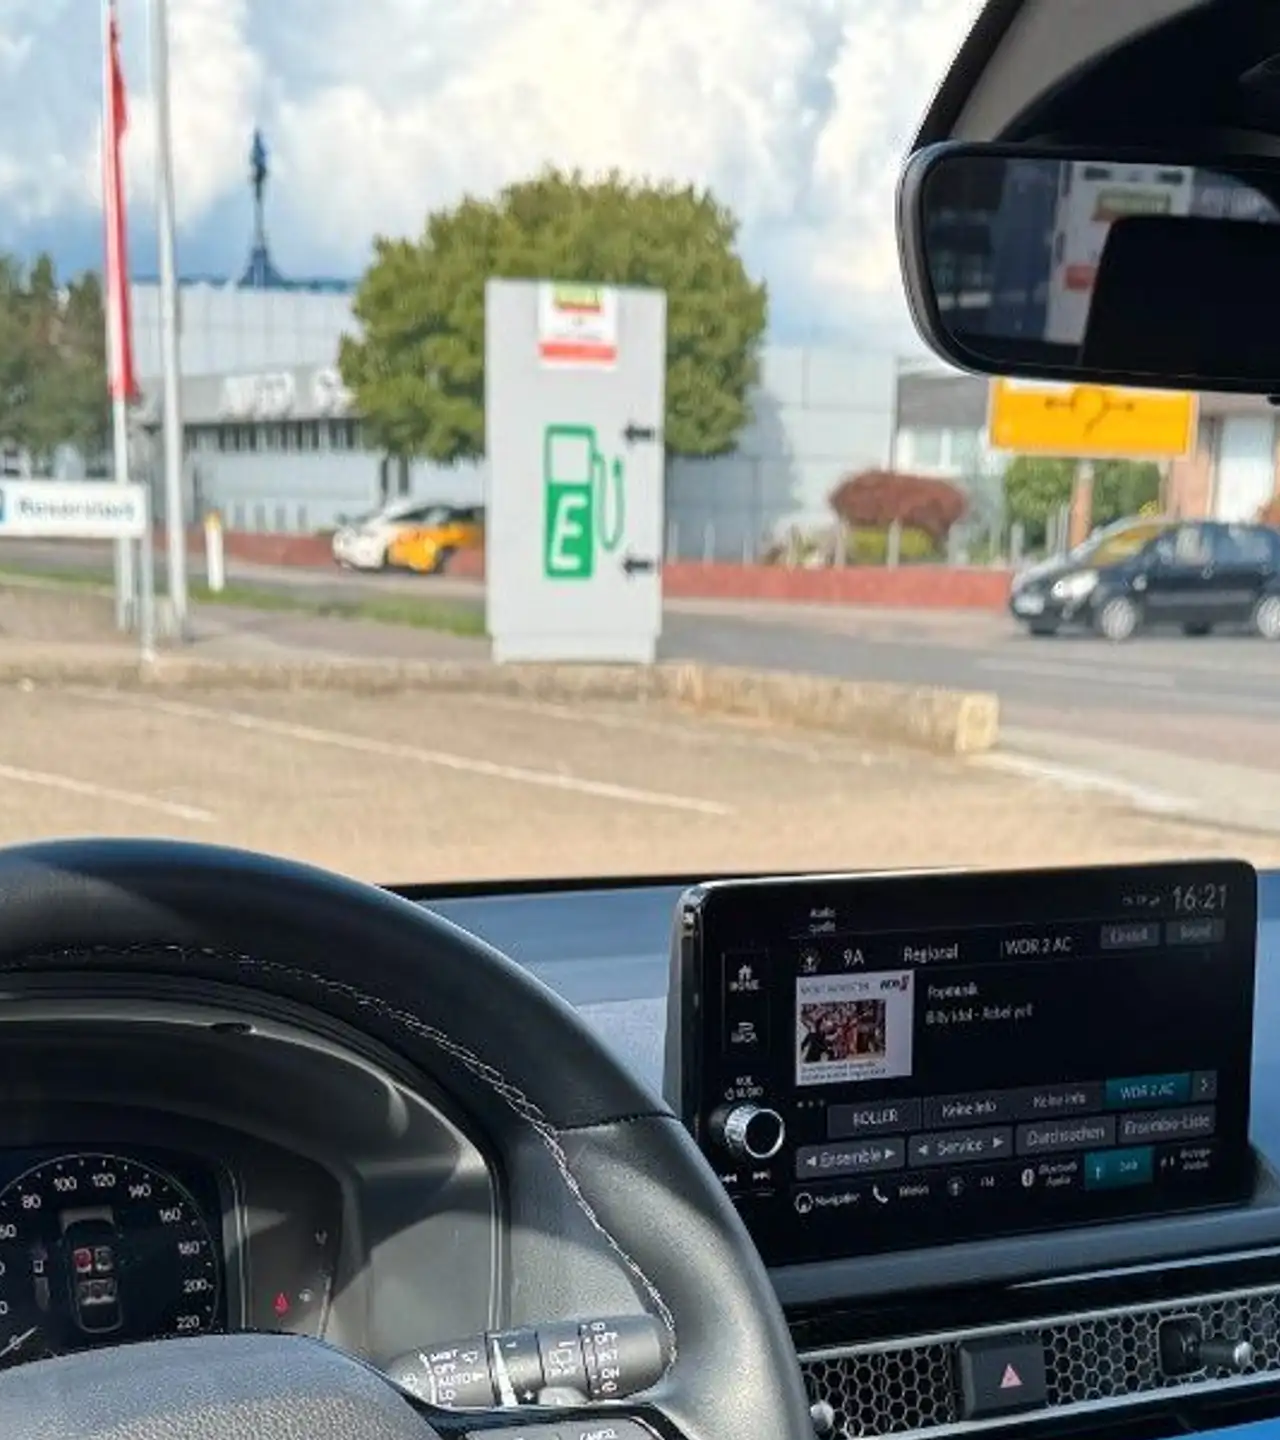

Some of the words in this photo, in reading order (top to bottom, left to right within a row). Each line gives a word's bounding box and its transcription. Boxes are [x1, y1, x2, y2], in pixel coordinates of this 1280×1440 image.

[550, 494, 588, 570] E
[1173, 884, 1227, 911] 16:21
[903, 943, 959, 965] Regional
[1006, 938, 1040, 956] WDR
[1052, 936, 1071, 953] AC
[937, 1138, 984, 1156] Service
[820, 1150, 883, 1169] Ensemble
[53, 1177, 77, 1192] 100
[92, 1174, 116, 1188] 120
[128, 1183, 152, 1199] 140
[21, 1195, 42, 1210] 80
[159, 1208, 182, 1224] 160
[178, 1241, 201, 1255] 180
[183, 1279, 207, 1294] 200
[176, 1315, 200, 1331] 220
